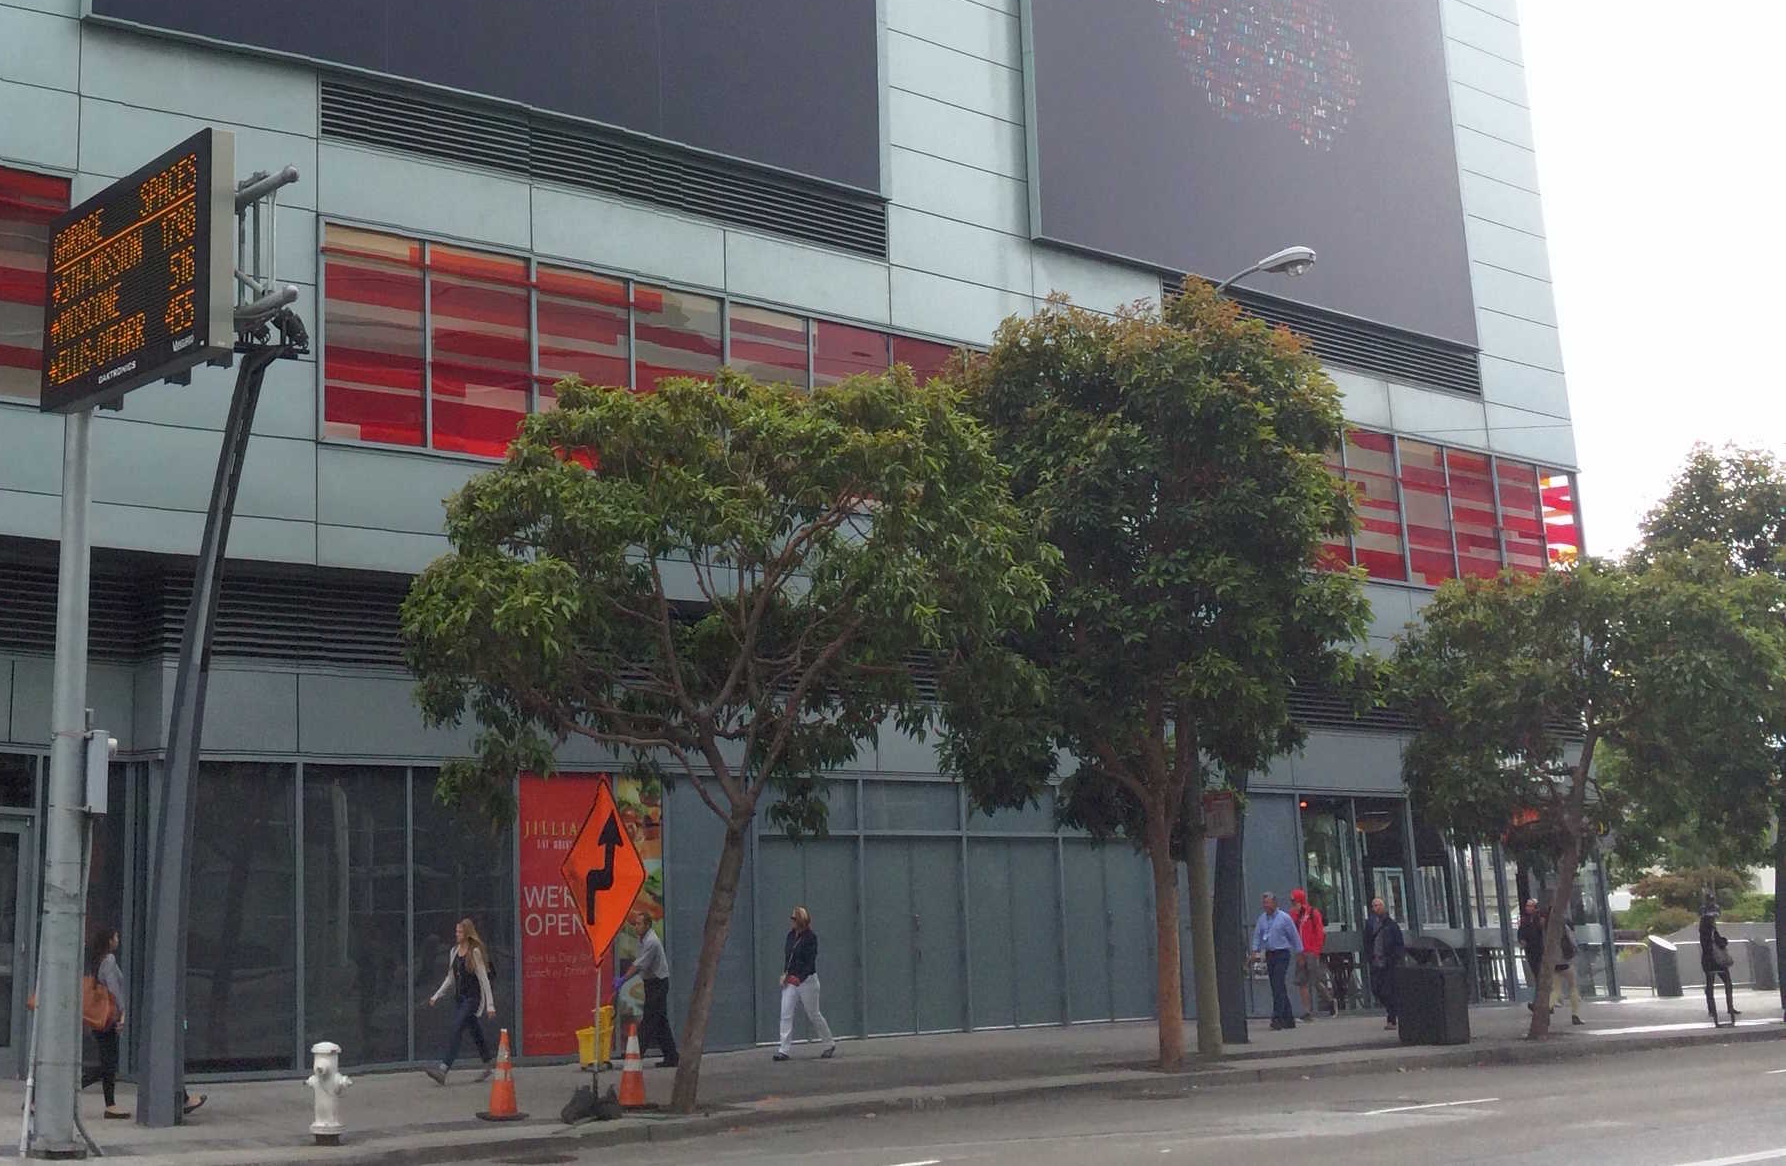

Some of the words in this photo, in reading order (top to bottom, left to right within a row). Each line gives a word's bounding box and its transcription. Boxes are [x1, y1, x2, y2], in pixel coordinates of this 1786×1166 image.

[53, 208, 104, 265] GARAGE
[140, 153, 197, 217] SPACES
[164, 288, 196, 334] 455
[524, 913, 586, 937] OPEN
